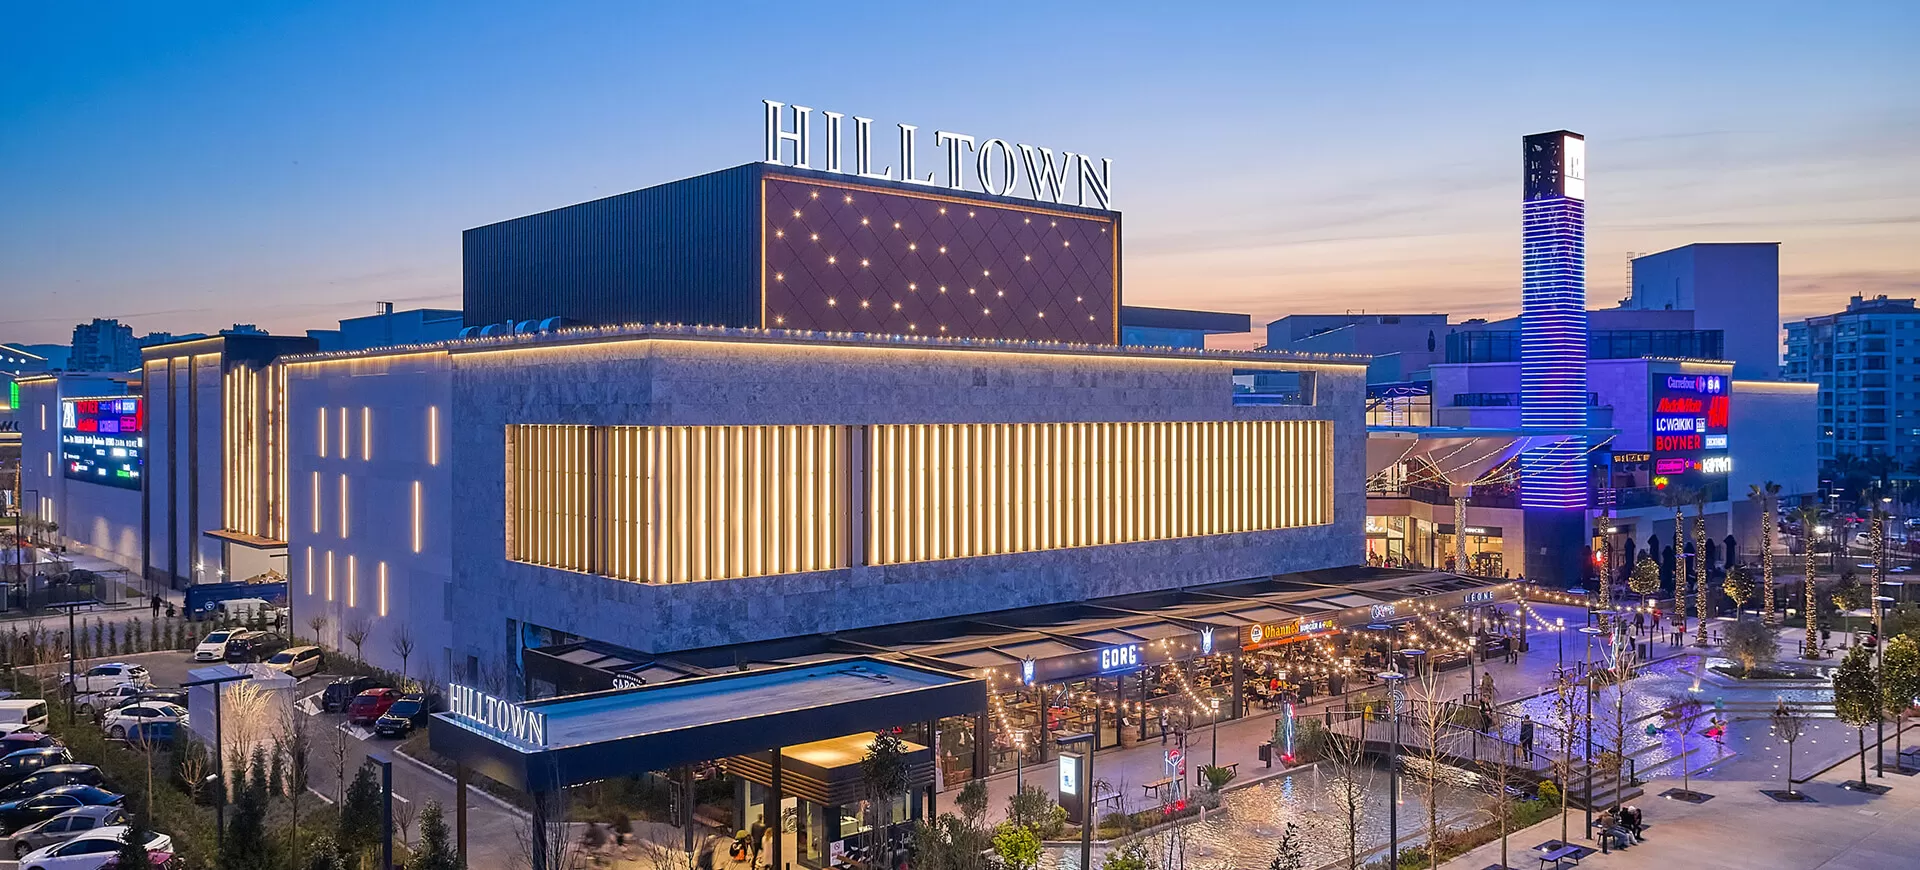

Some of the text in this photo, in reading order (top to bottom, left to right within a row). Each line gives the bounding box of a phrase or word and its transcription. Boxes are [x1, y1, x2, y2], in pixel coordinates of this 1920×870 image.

[762, 99, 1113, 210] HILLTOWN
[1656, 435, 1701, 451] BOYNER
[1102, 645, 1136, 669] GORG
[449, 682, 543, 747] HILLTOWN
